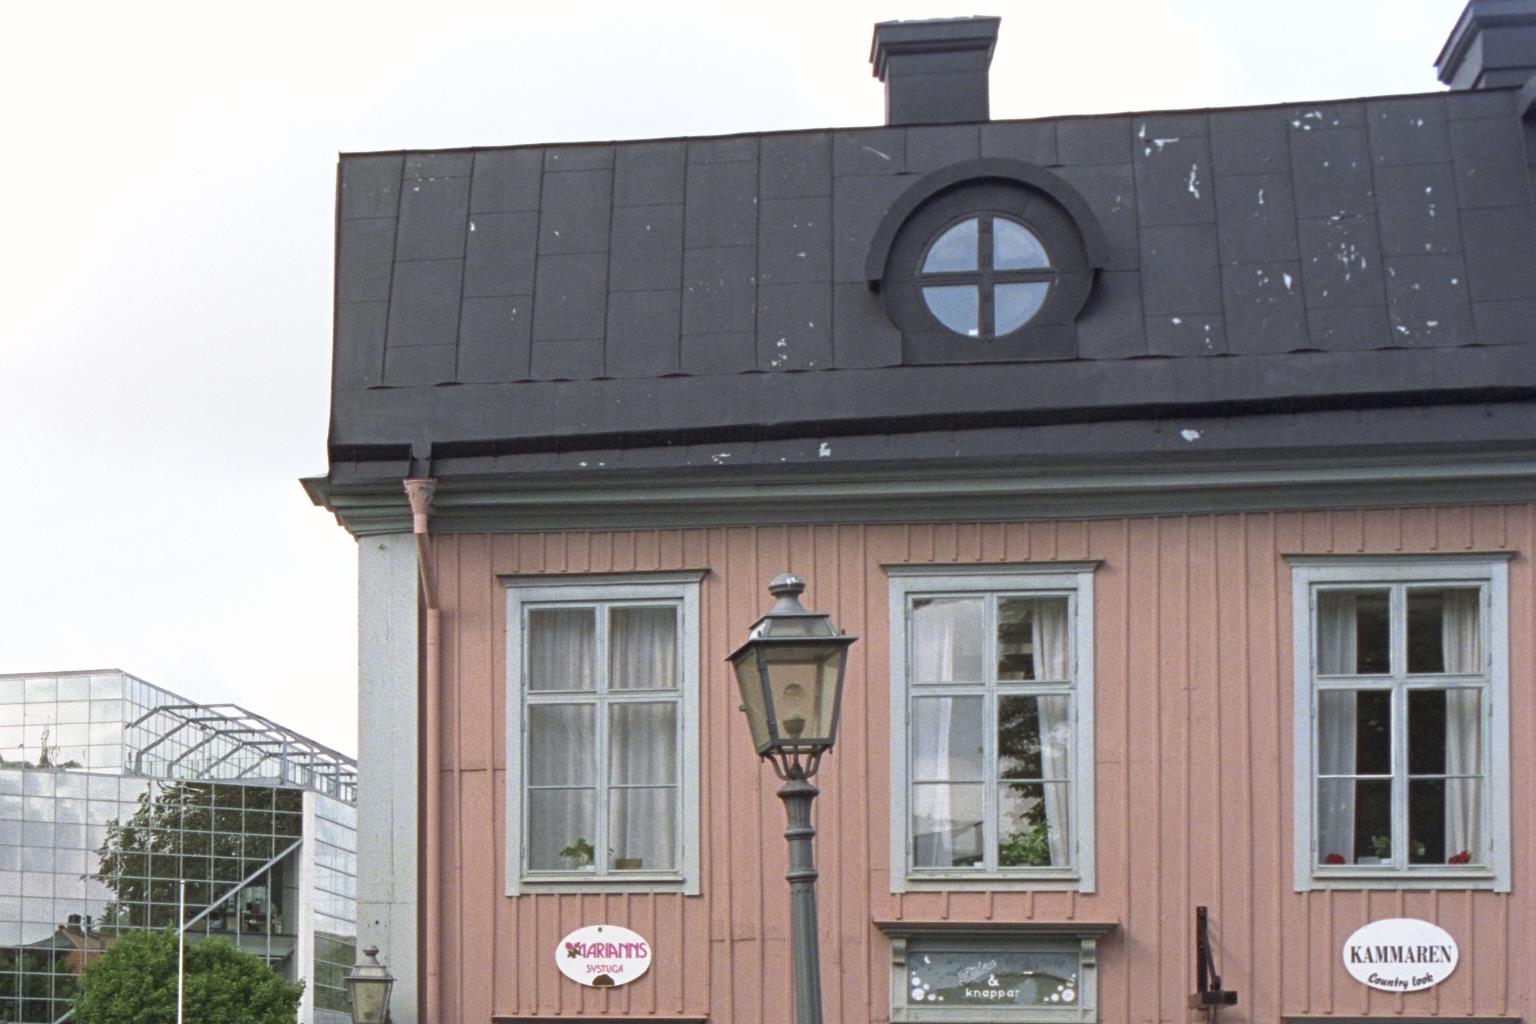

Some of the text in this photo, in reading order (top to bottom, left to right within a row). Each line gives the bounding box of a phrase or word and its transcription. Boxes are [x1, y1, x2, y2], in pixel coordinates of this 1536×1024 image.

[1350, 945, 1452, 963] KAMMAREN
[585, 964, 624, 973] SYSTUGA
[987, 974, 1000, 987] &
[1368, 972, 1434, 989] Country look
[965, 988, 1020, 999] knappar
